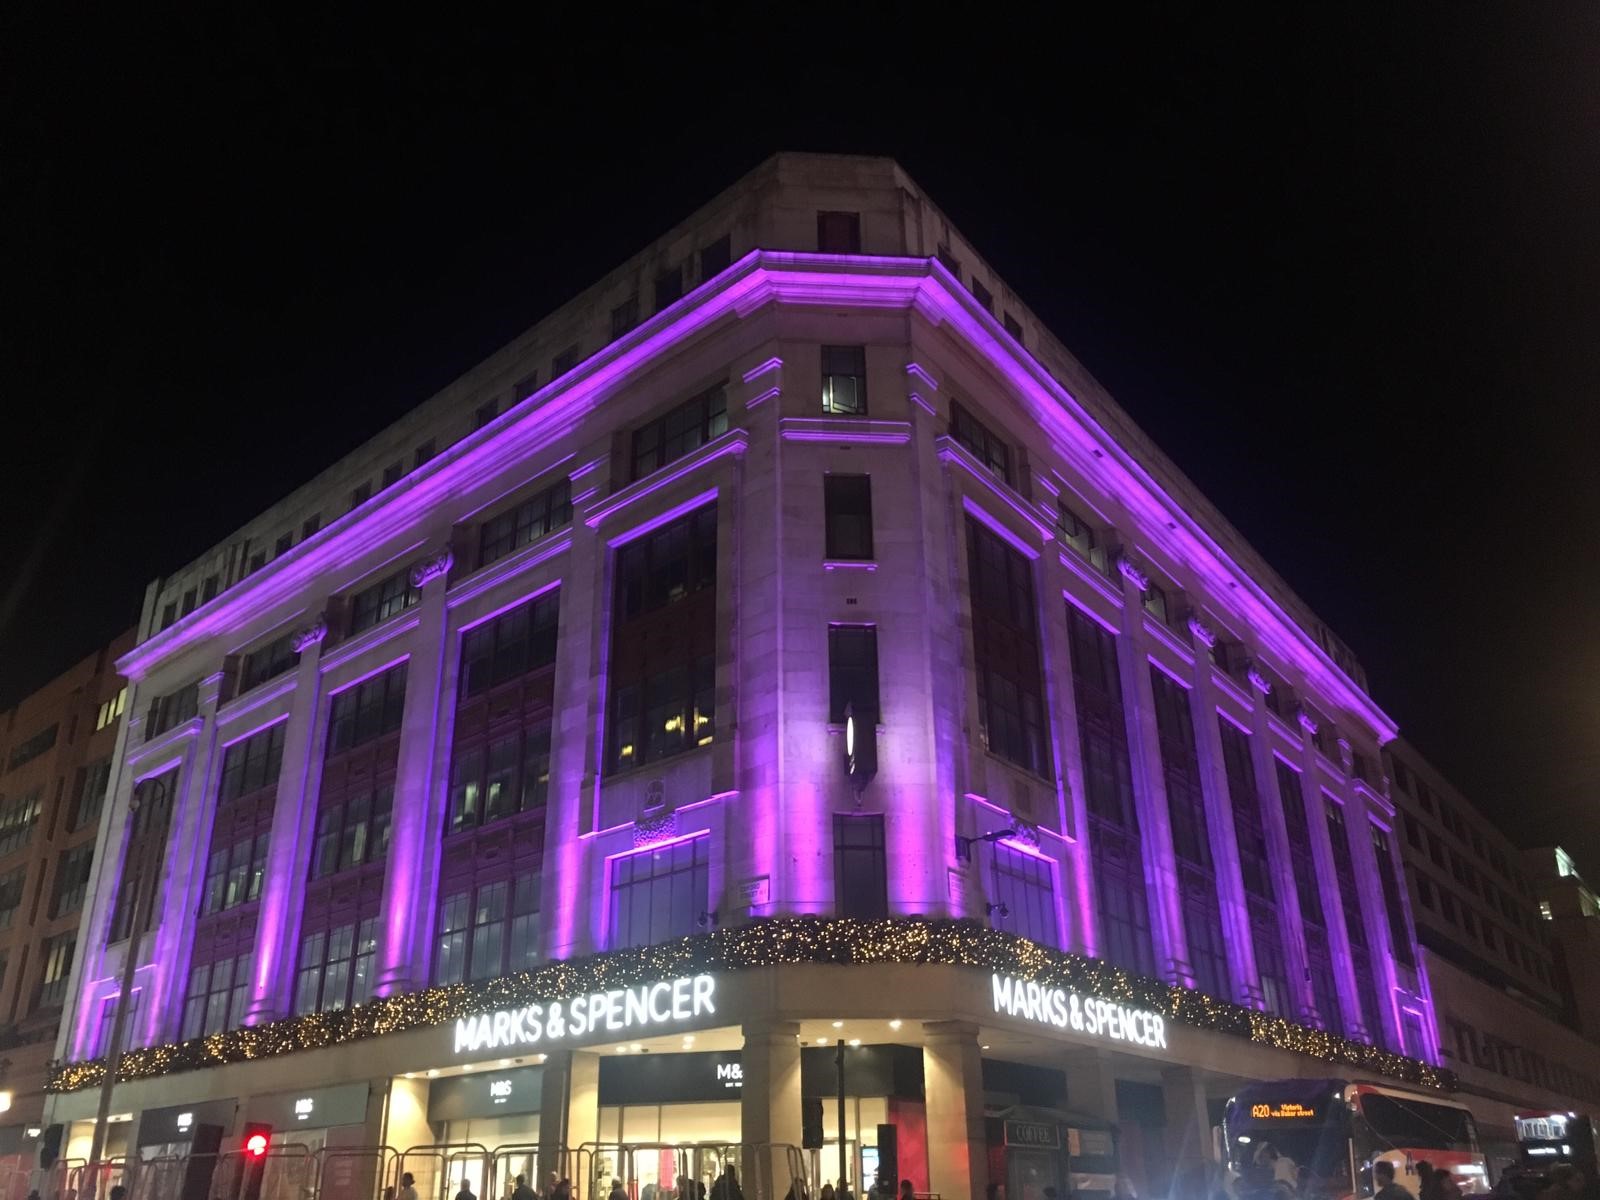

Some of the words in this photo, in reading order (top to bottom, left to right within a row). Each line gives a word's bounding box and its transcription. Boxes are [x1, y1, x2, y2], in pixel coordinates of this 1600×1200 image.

[454, 1003, 544, 1054] MARKS
[546, 1002, 565, 1039] &
[568, 974, 716, 1036] SPENCER
[991, 973, 1068, 1028] MARKS
[1069, 993, 1085, 1032] &
[1084, 997, 1168, 1049] SPENCER
[1252, 1104, 1270, 1118] A20
[1280, 1103, 1303, 1111] Victoria
[1015, 1124, 1050, 1144] COFFEE
